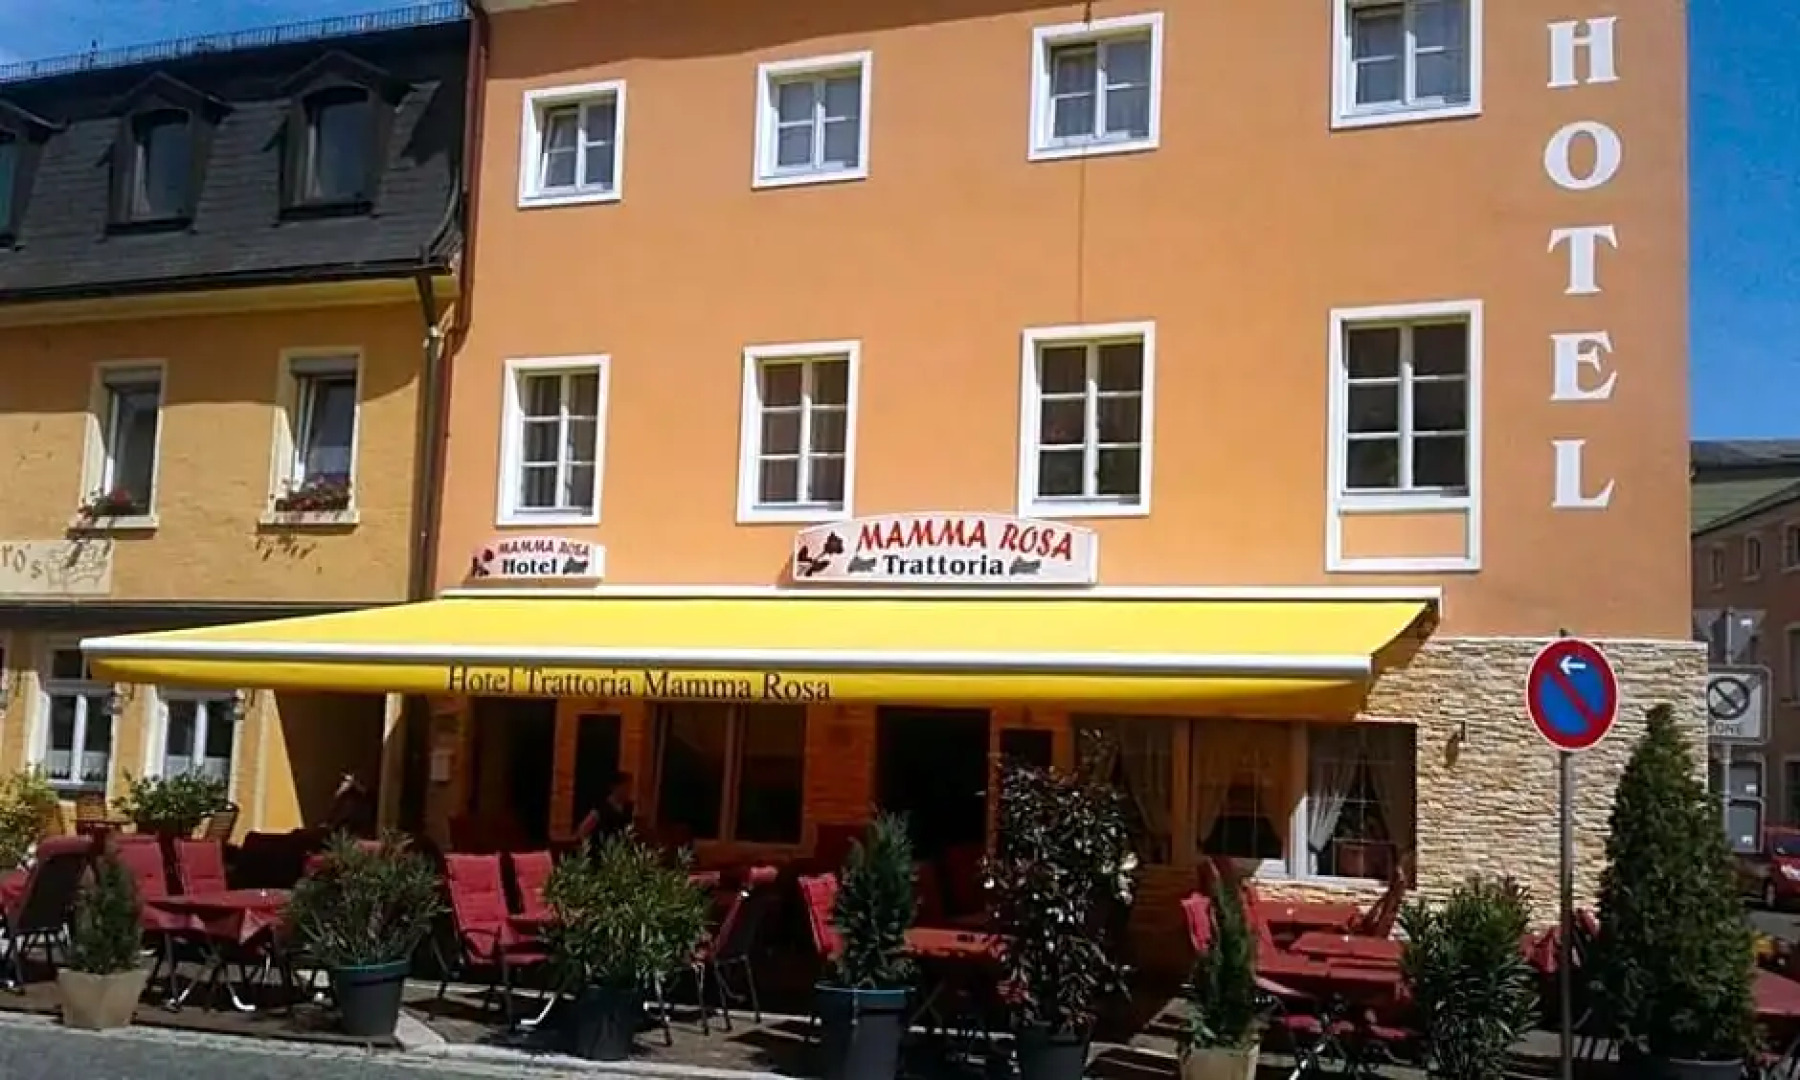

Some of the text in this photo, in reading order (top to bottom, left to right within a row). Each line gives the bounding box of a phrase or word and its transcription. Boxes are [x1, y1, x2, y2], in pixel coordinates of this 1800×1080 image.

[1544, 15, 1622, 509] HOTEL
[498, 539, 555, 554] MAMMA
[857, 519, 1073, 560] MAMMA ROSA
[502, 558, 557, 575] Hotel
[883, 554, 1003, 575] Trattoria
[448, 664, 831, 703] Hotel Trattoria Mamma Rosa
